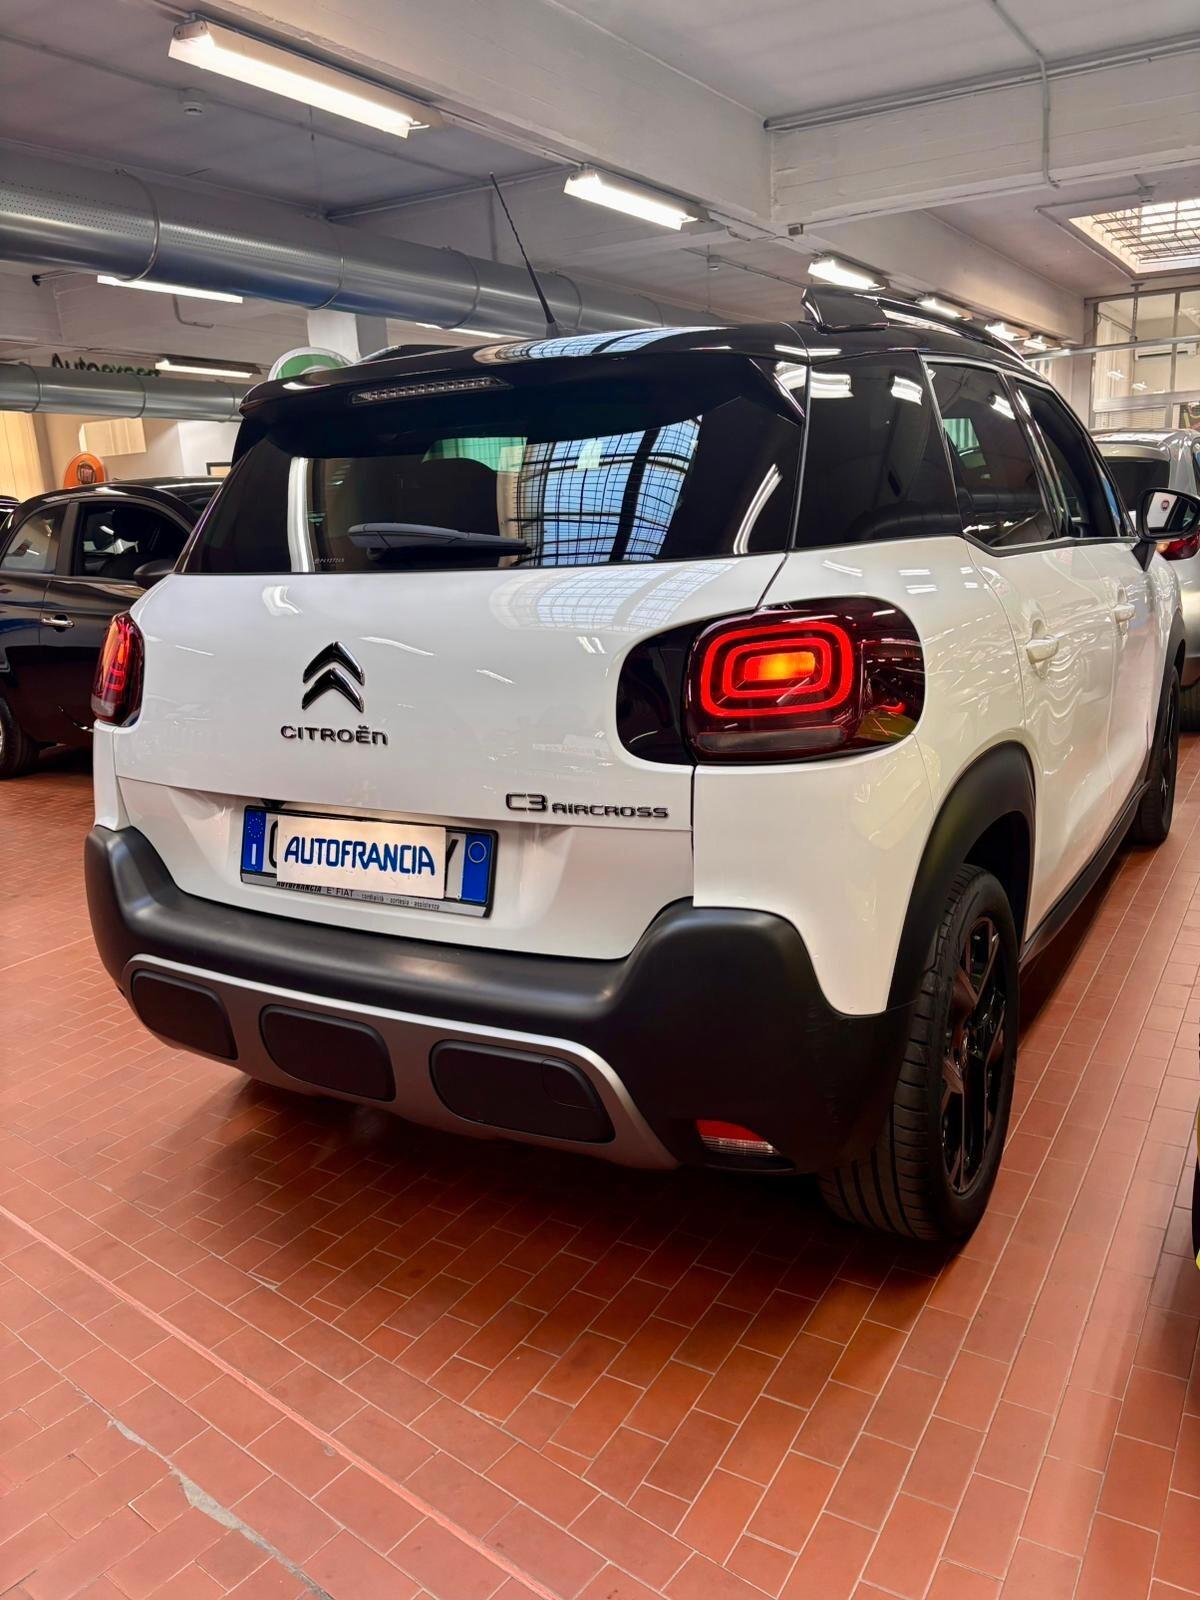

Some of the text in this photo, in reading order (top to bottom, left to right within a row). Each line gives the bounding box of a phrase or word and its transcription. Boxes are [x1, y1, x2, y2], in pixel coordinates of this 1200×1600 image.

[505, 793, 669, 819] C3 AIRCROSS
[251, 843, 257, 865] I
[284, 836, 435, 876] AUTOFRANCIA
[276, 881, 322, 893] AUTOFRANCIA
[336, 888, 354, 897] FIAT
